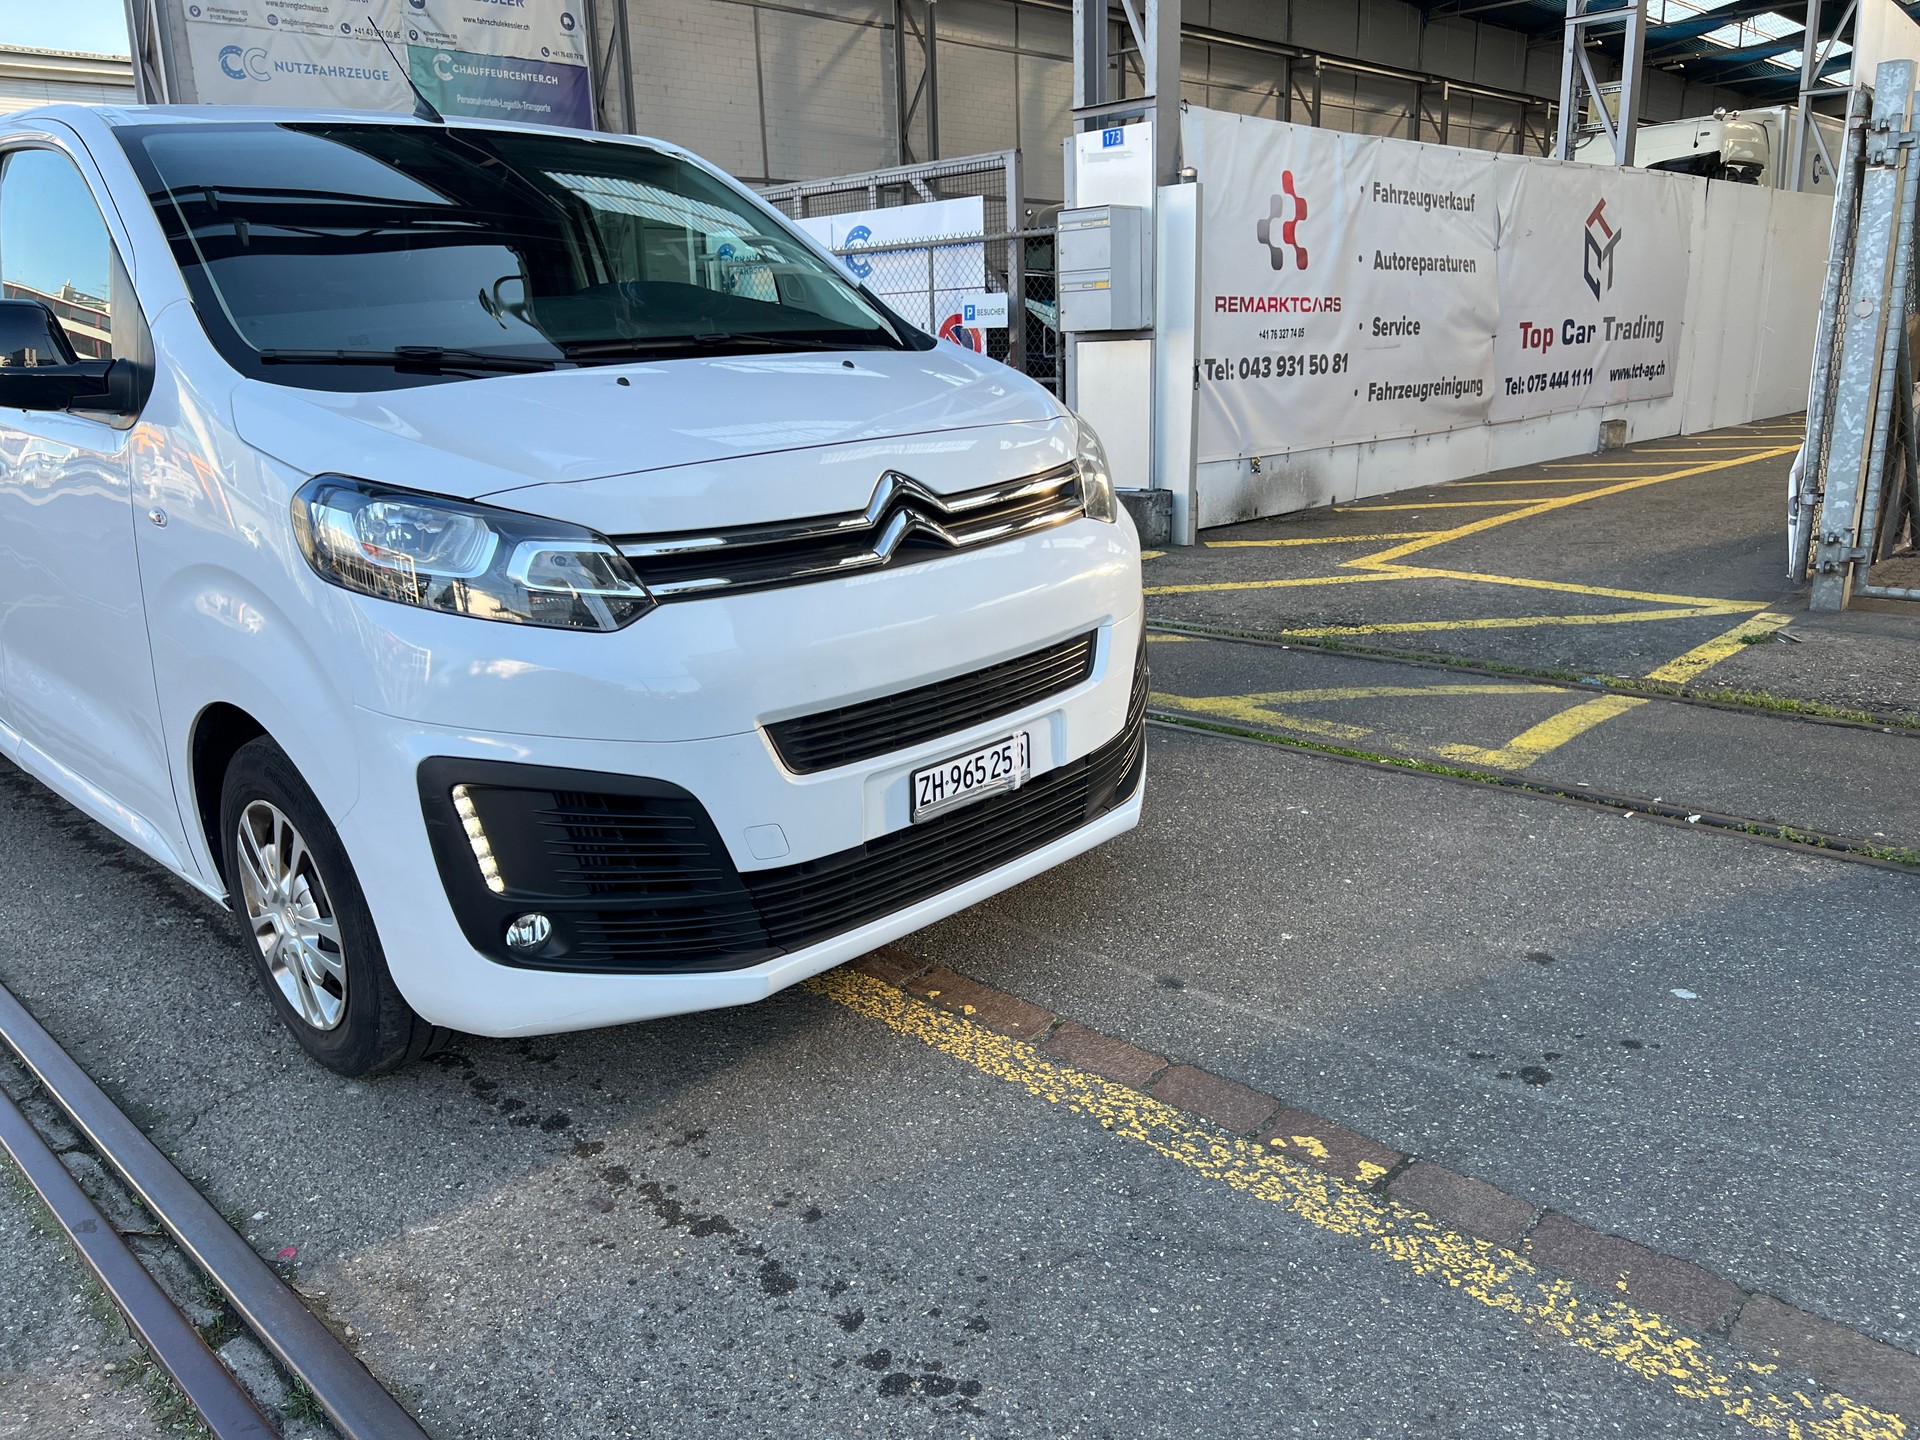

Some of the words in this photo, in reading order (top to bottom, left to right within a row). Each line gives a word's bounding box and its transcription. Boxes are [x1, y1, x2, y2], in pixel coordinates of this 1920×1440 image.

[463, 16, 530, 31] www.fahrschulekessler.ch
[274, 60, 390, 81] NUTZFAHRZEUGE
[452, 64, 559, 85] CHAUFFEURCENTER.CH
[1104, 130, 1121, 145] 173
[1373, 181, 1475, 212] Fahrzeugverkauf
[1373, 249, 1476, 276] Autoreparaturen
[976, 307, 1005, 316] BESUCHER
[1214, 295, 1342, 313] REMARKTCARS
[1259, 329, 1269, 340] +41
[1270, 329, 1277, 340] 76
[1279, 328, 1289, 339] 327
[1290, 328, 1297, 338] 74
[1298, 327, 1305, 338] 05
[1372, 315, 1420, 336] Service
[1519, 321, 1553, 354] Top
[1562, 318, 1596, 345] Car
[1603, 314, 1664, 343] Trading
[1204, 358, 1234, 380] Tel:
[1239, 356, 1272, 380] 043
[1276, 355, 1304, 377] 931
[1309, 353, 1329, 375] 50
[1332, 352, 1349, 374] 81
[1609, 360, 1666, 382] www.tct-ag.ch
[1368, 375, 1483, 402] Fahrzeugreinigung
[1505, 376, 1525, 395] Tel:
[1527, 373, 1547, 393] 075
[1549, 370, 1569, 390] 444
[1571, 369, 1580, 387] 11
[1583, 367, 1593, 385] 11
